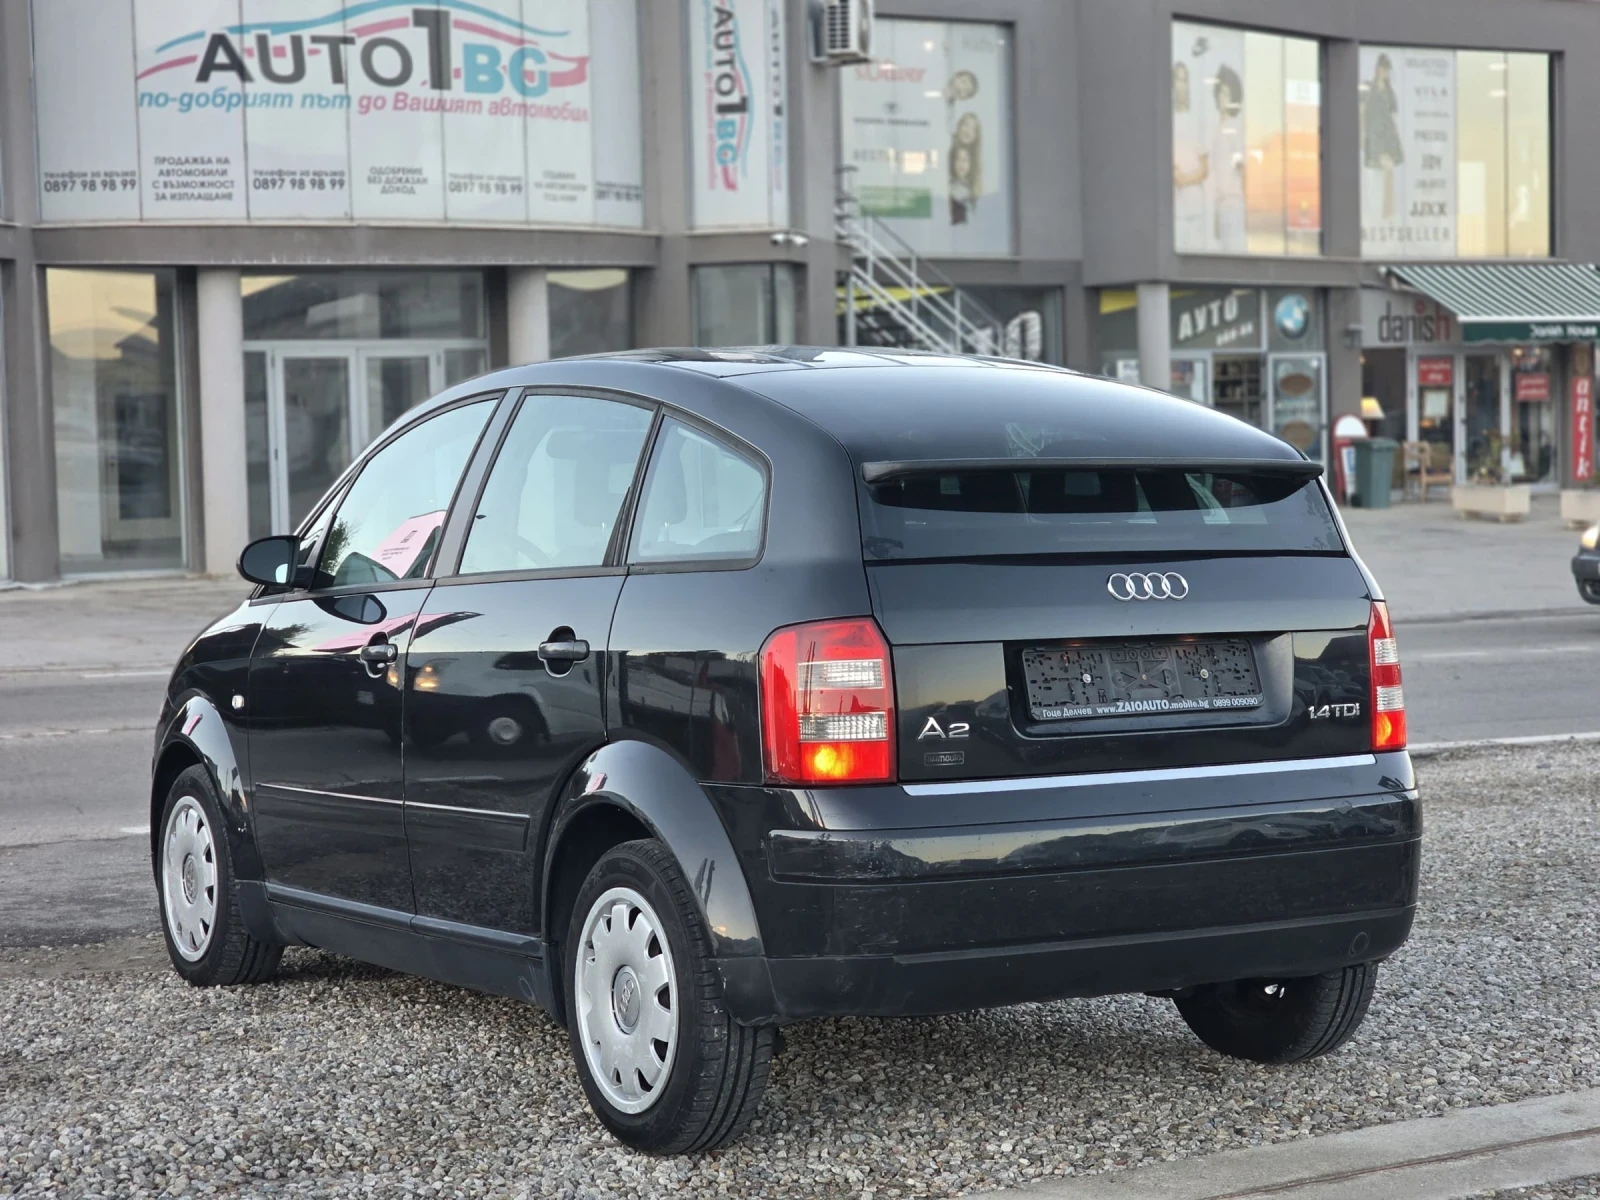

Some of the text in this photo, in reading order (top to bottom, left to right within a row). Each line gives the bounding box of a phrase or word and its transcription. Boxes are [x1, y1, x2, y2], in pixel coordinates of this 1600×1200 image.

[357, 92, 387, 115] до
[153, 156, 230, 166] ПРОДАЖБА НА
[158, 168, 229, 177] АВТОМОБИЛИ
[44, 179, 137, 193] 0897 98 98 99
[253, 178, 346, 190] 0897 98 98 99
[1378, 301, 1450, 344] danish
[1042, 708, 1062, 718] Гоце
[1063, 707, 1092, 718] Делчев
[1213, 699, 1231, 707] 0899
[917, 716, 970, 740] A2
